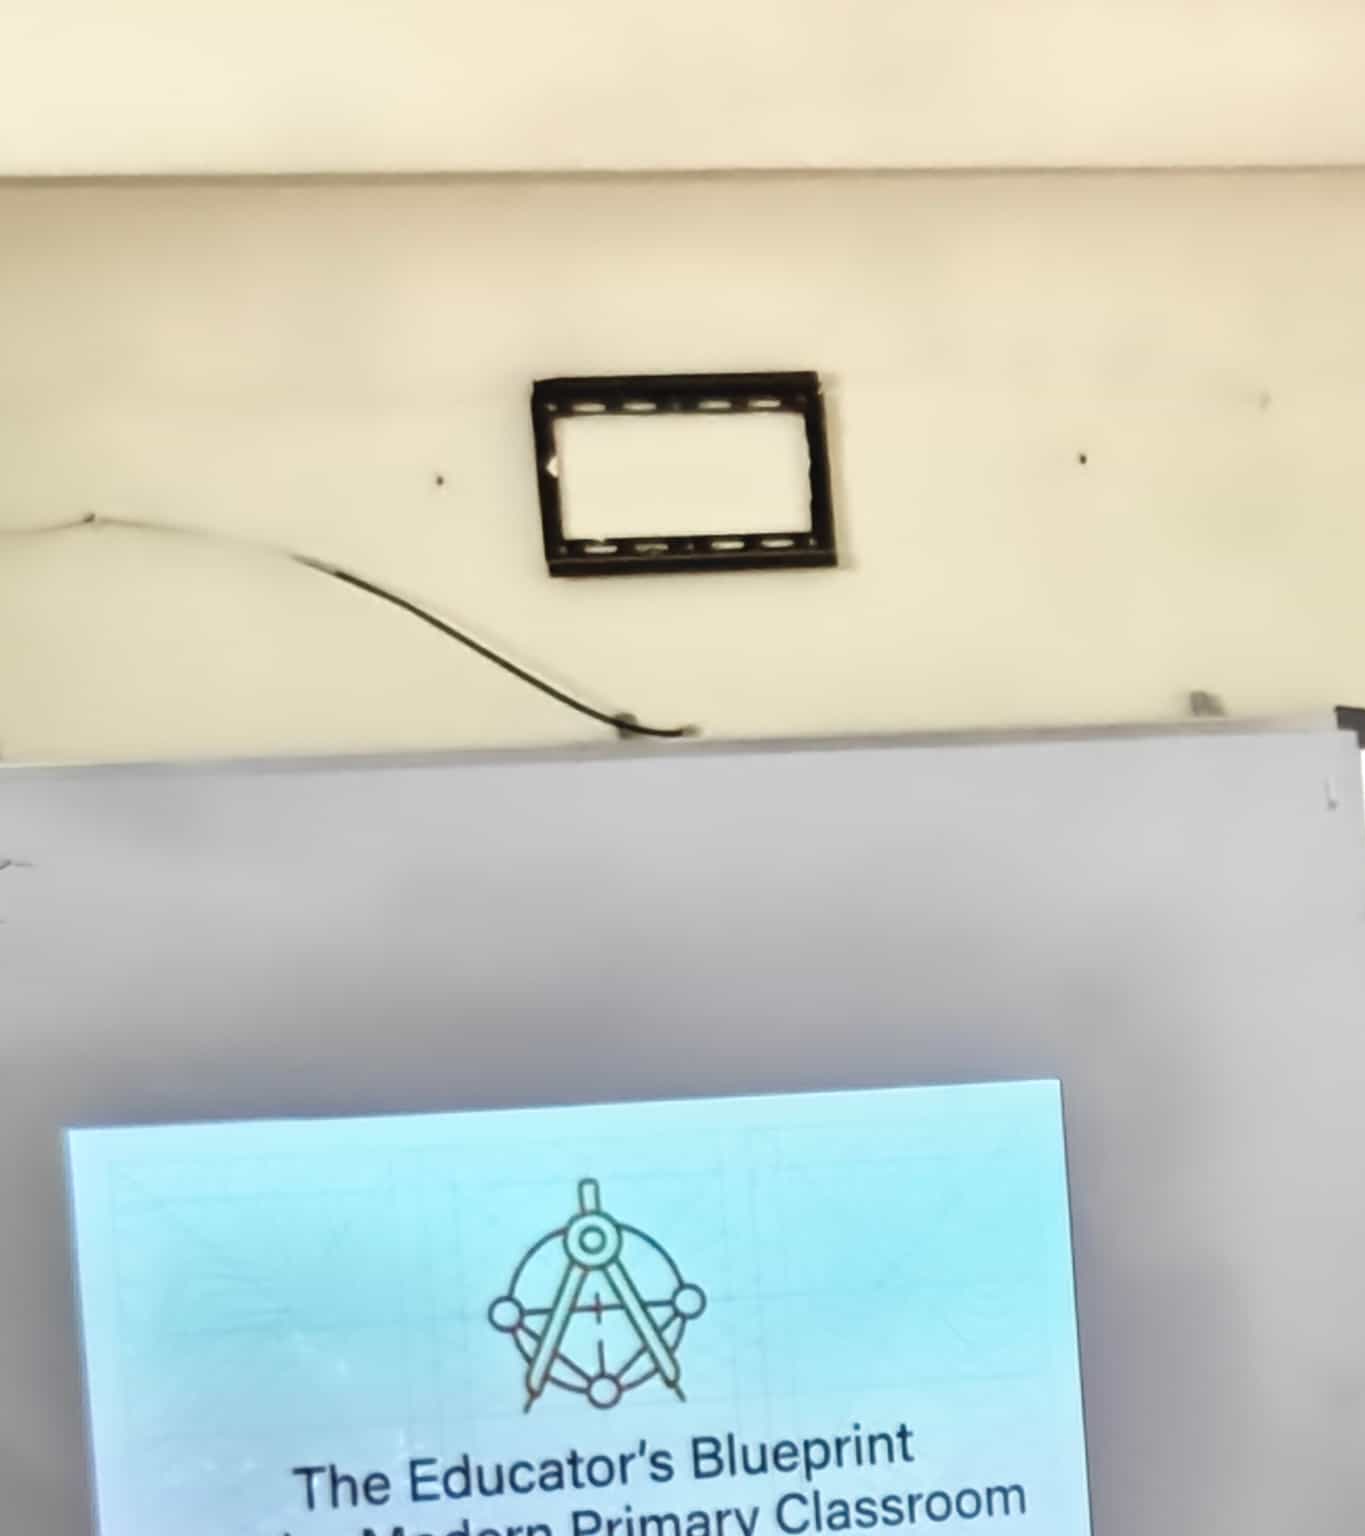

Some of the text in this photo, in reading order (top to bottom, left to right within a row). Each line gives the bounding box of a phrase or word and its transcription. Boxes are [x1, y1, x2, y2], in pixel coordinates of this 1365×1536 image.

[293, 1422, 915, 1511] The Educator's Blueprint
[775, 1482, 1027, 1535] Classroom
